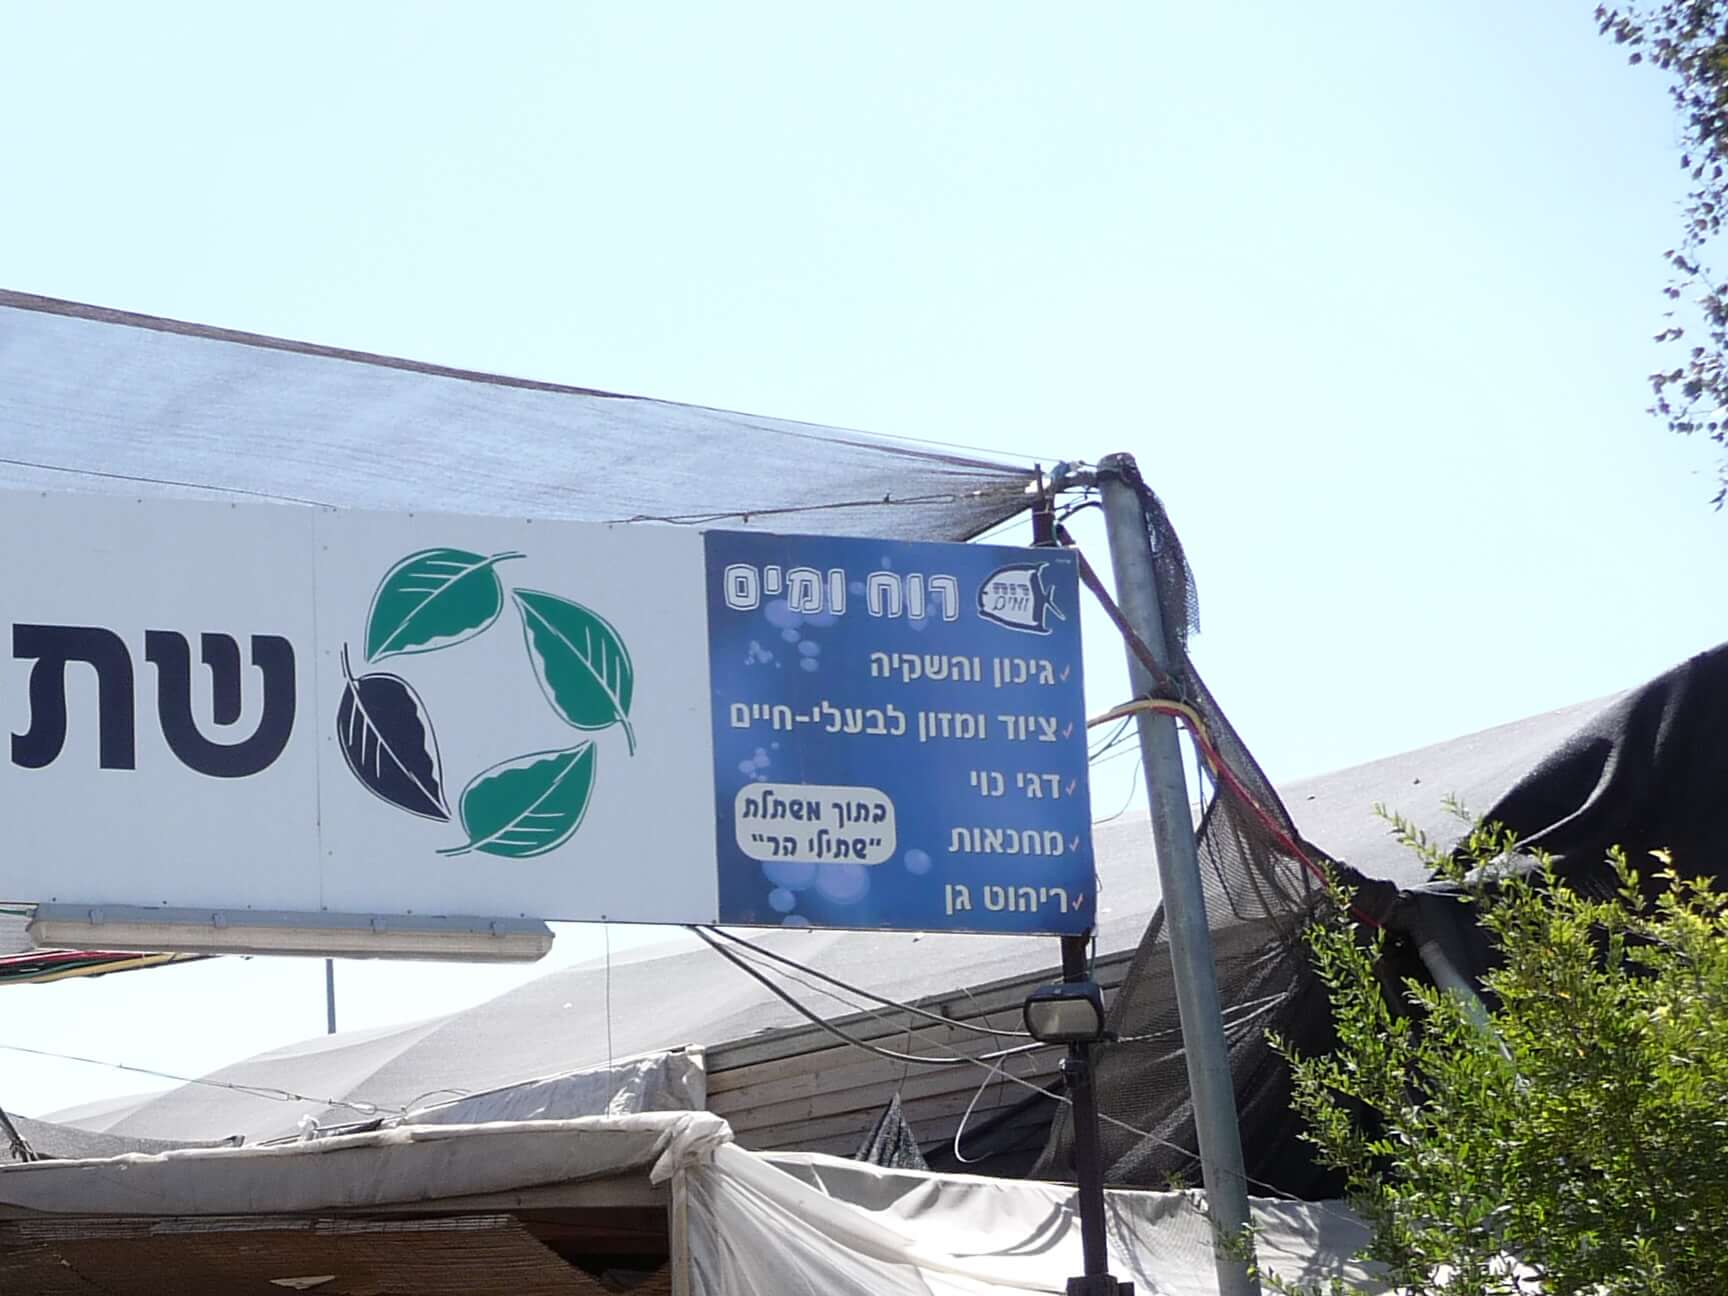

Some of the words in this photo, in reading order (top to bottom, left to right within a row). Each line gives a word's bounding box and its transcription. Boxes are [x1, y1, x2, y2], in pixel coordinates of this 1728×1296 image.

[723, 563, 847, 616] ומים
[866, 570, 960, 622] רוח
[870, 651, 981, 683] והשקיה
[992, 657, 1055, 688] גינון
[918, 711, 986, 743] ומזון
[997, 714, 1058, 742] ציוד
[970, 770, 1004, 797] נוי
[1016, 772, 1061, 799] דגי
[742, 789, 821, 822] משתלת
[832, 800, 887, 829] בתוך
[948, 826, 1064, 856] מחנאות
[945, 883, 972, 915] גן
[983, 885, 1068, 913] ריהוט
